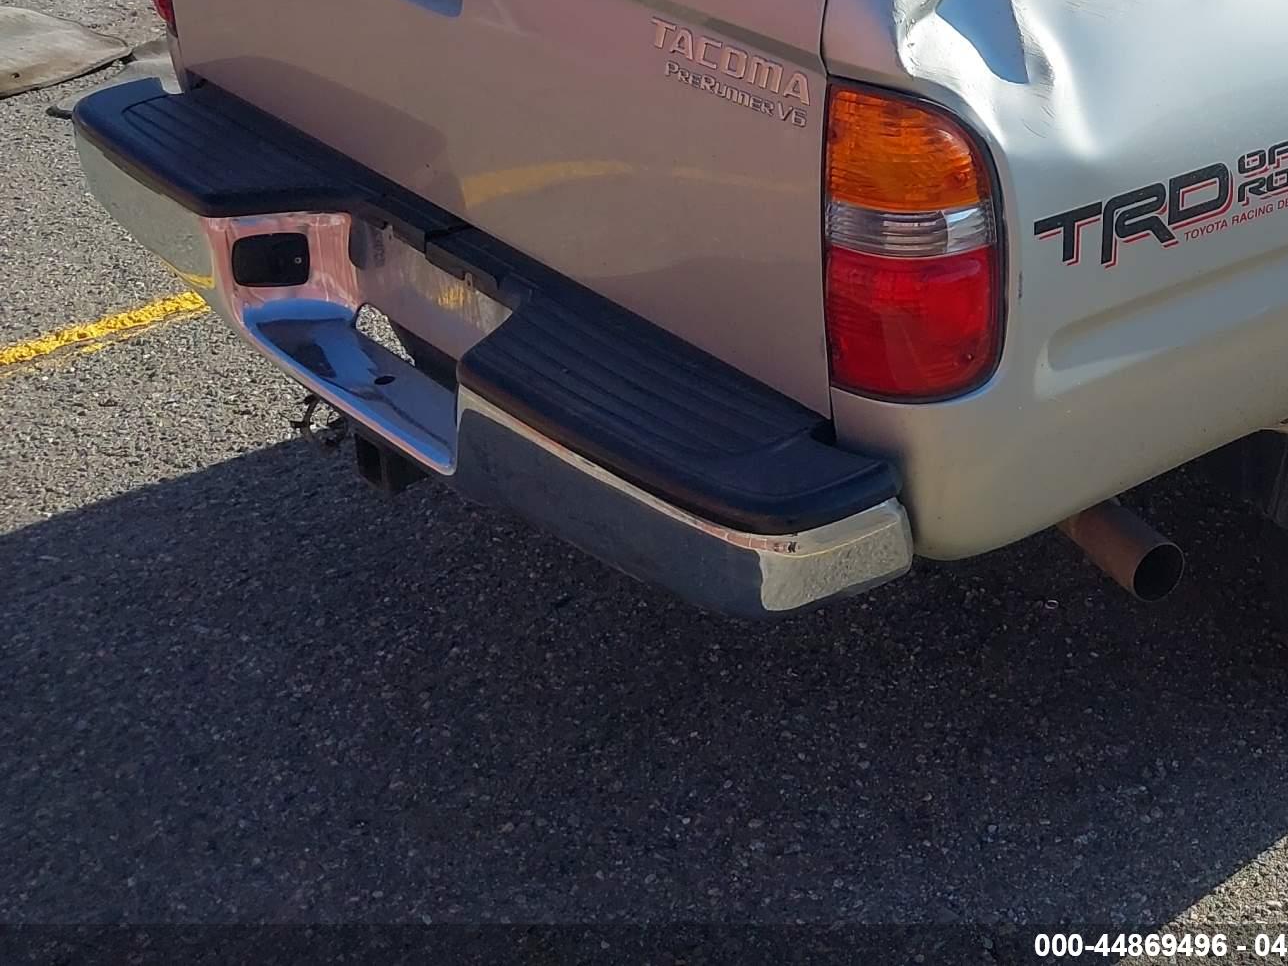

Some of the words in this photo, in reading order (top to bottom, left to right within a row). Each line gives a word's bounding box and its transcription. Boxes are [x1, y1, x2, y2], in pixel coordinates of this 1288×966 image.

[651, 17, 811, 106] TACOMA
[1033, 162, 1234, 270] TRD
[1184, 220, 1229, 242] TOYOTA
[1231, 203, 1275, 227] RACING
